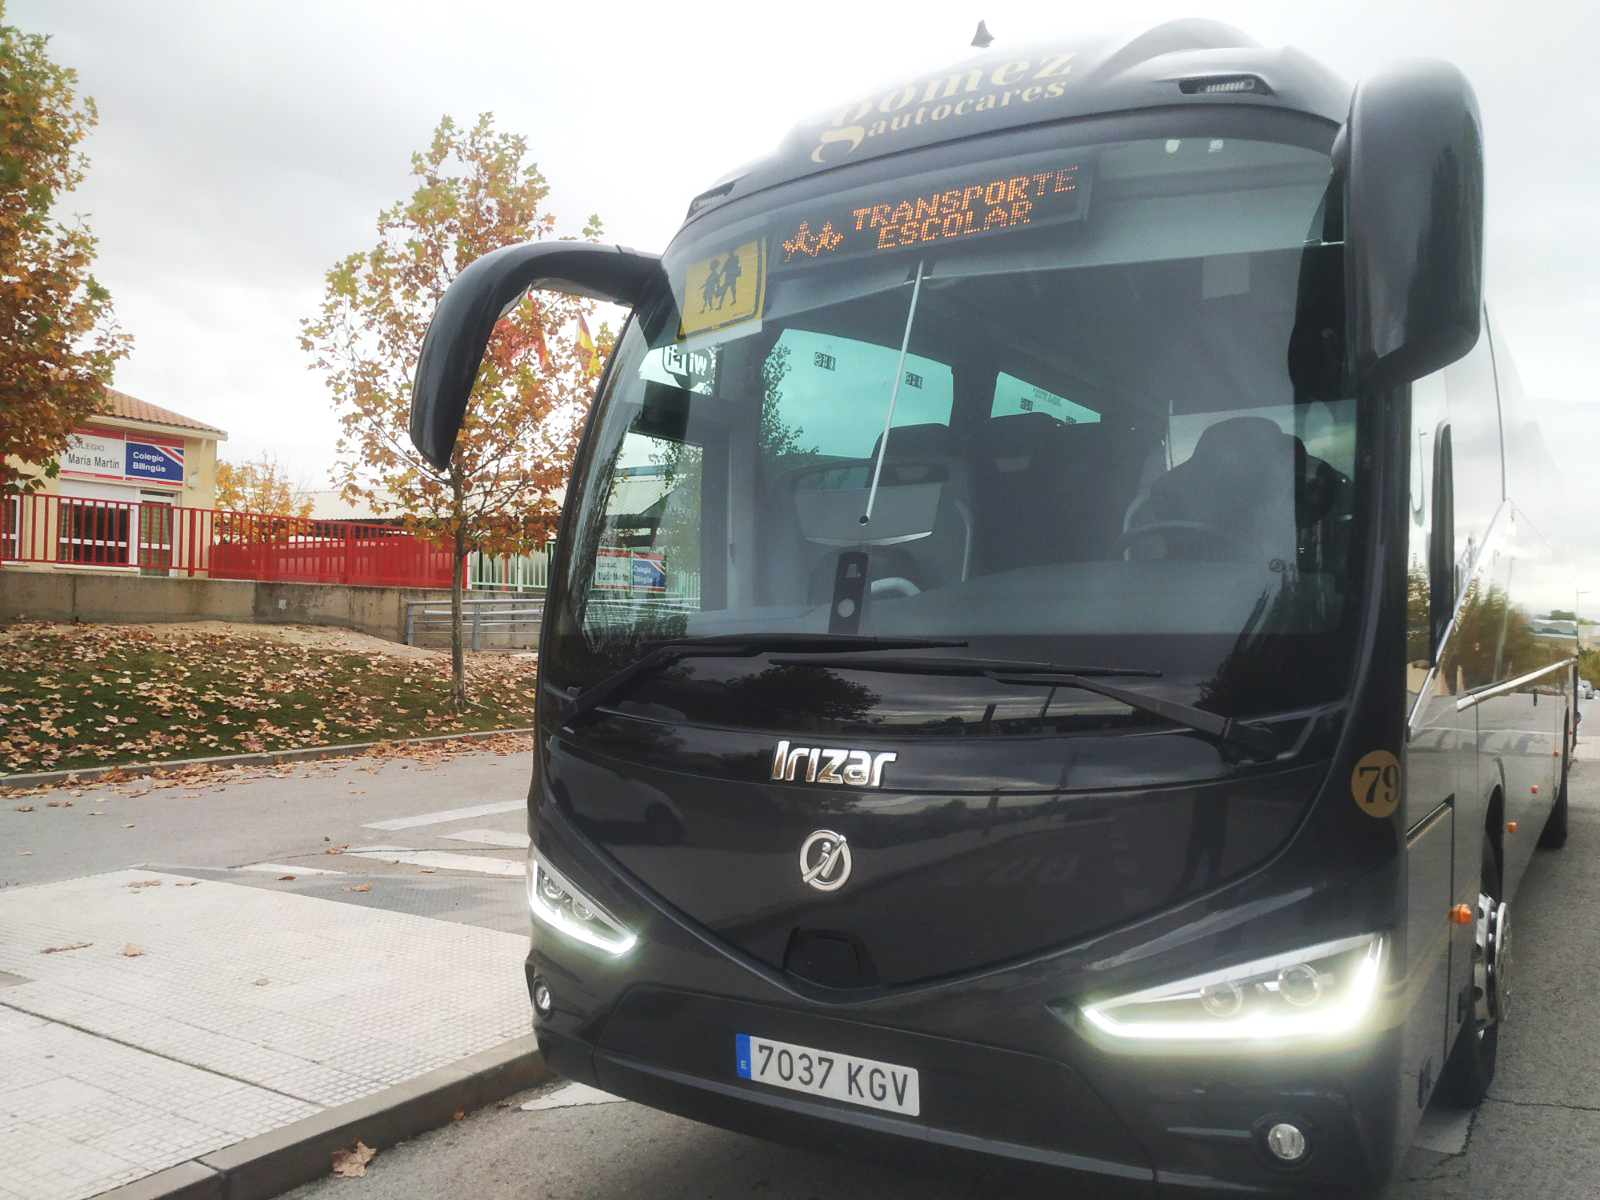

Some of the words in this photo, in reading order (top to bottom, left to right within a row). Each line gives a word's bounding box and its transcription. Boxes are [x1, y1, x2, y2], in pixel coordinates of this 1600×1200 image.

[867, 80, 1067, 138] autocares
[852, 165, 1079, 231] TRANSPORTE
[876, 200, 1033, 250] ESCOLAR
[133, 451, 164, 463] Colegio
[772, 740, 897, 787] Irizar
[1359, 764, 1400, 803] 79
[741, 1060, 747, 1070] E
[758, 1044, 834, 1089] 7037
[847, 1062, 908, 1106] KGV
